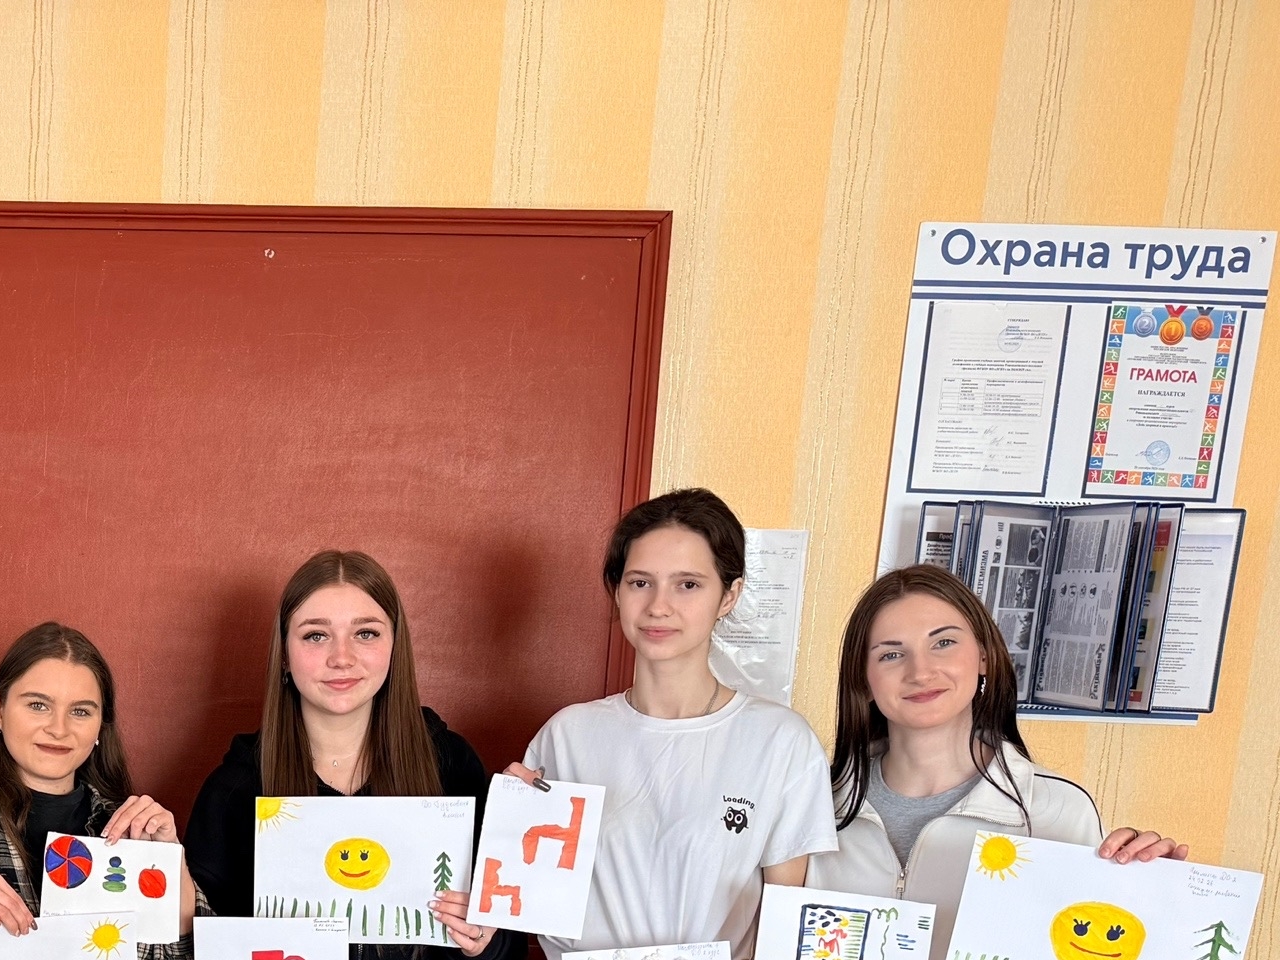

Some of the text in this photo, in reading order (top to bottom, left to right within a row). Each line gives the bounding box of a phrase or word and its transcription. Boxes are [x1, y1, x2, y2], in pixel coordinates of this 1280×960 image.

[940, 228, 1251, 281] Охрана труда
[1129, 367, 1198, 384] ГРАМОТА
[1137, 389, 1186, 397] НАГРАЖДАЕТСЯ
